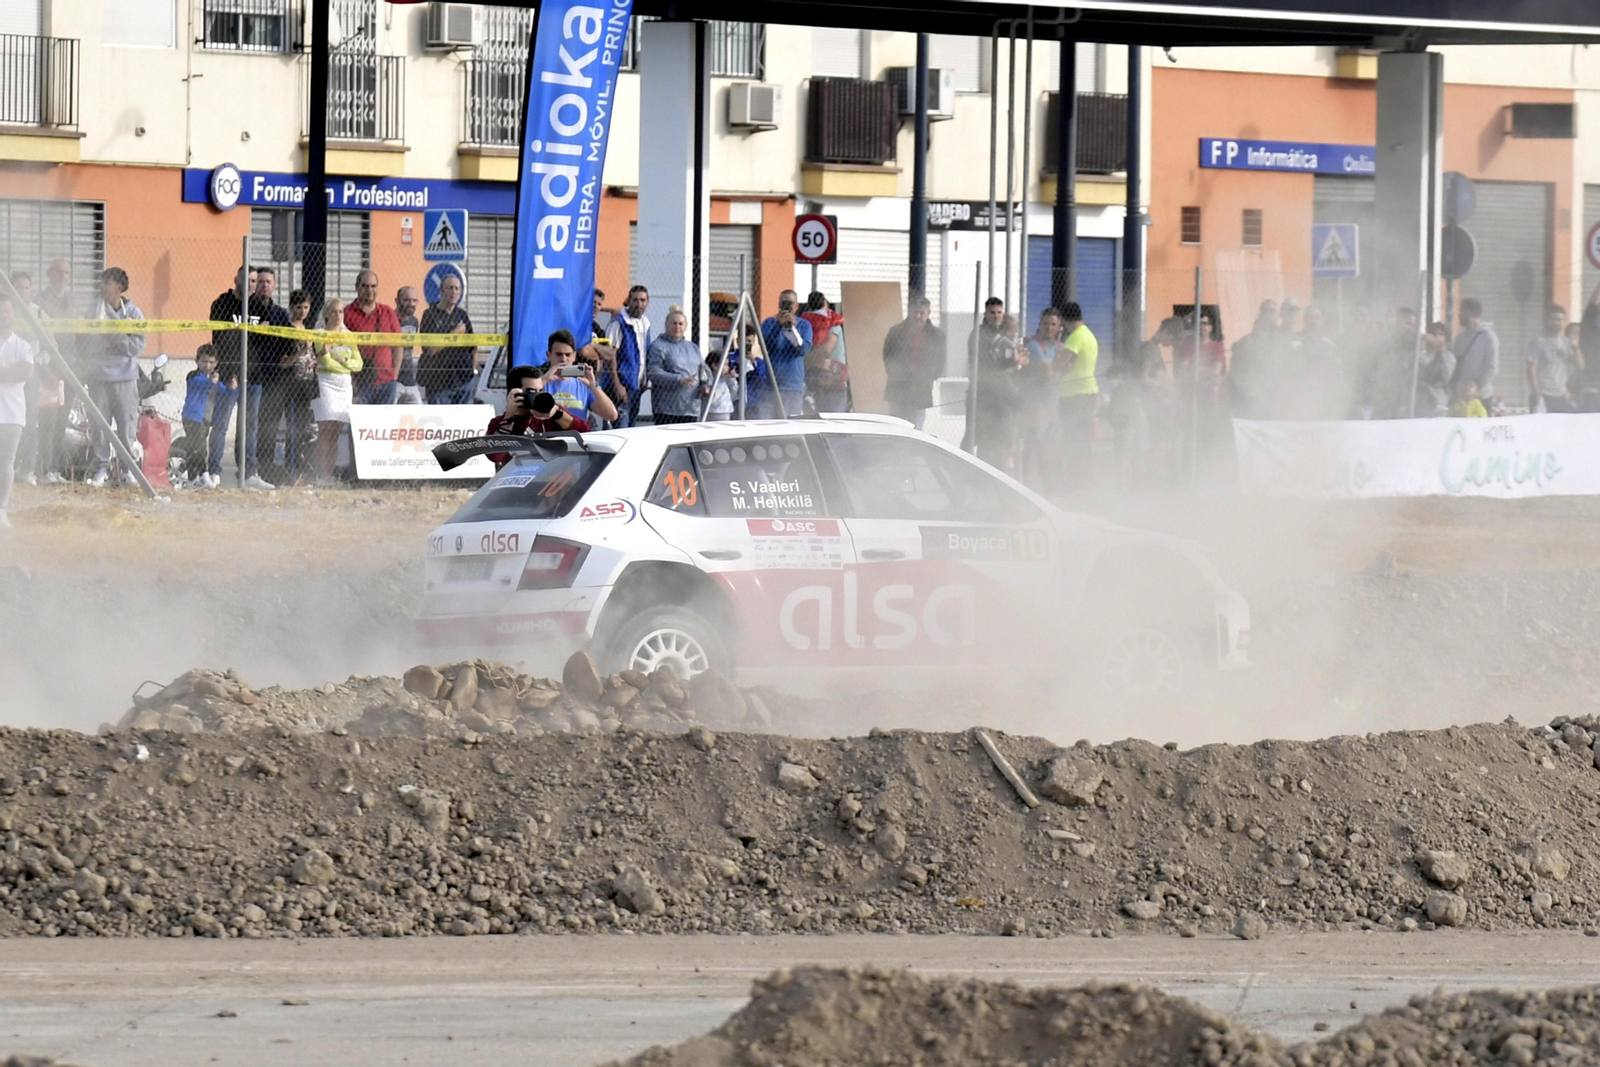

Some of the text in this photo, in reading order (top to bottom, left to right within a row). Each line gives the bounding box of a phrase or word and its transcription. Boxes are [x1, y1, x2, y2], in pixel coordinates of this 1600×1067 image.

[531, 5, 604, 279] radioka
[573, 175, 597, 253] FIBRA.
[586, 79, 611, 161] MÓVIL.
[1247, 147, 1318, 168] Informática
[218, 178, 239, 195] FOC
[343, 180, 428, 207] Profesional
[802, 231, 824, 247] 50
[1483, 425, 1515, 441] HOTEL
[446, 439, 522, 453] @bsrallyteam
[1440, 424, 1562, 493] Camino
[664, 470, 697, 506] 10
[729, 479, 800, 494] S. Vaaleri
[580, 502, 627, 517] ASR
[732, 494, 813, 510] M. Heikkilä
[786, 522, 816, 532] ASC
[481, 530, 519, 553] alsa
[1014, 531, 1050, 559] 10
[780, 570, 976, 650] alsa
